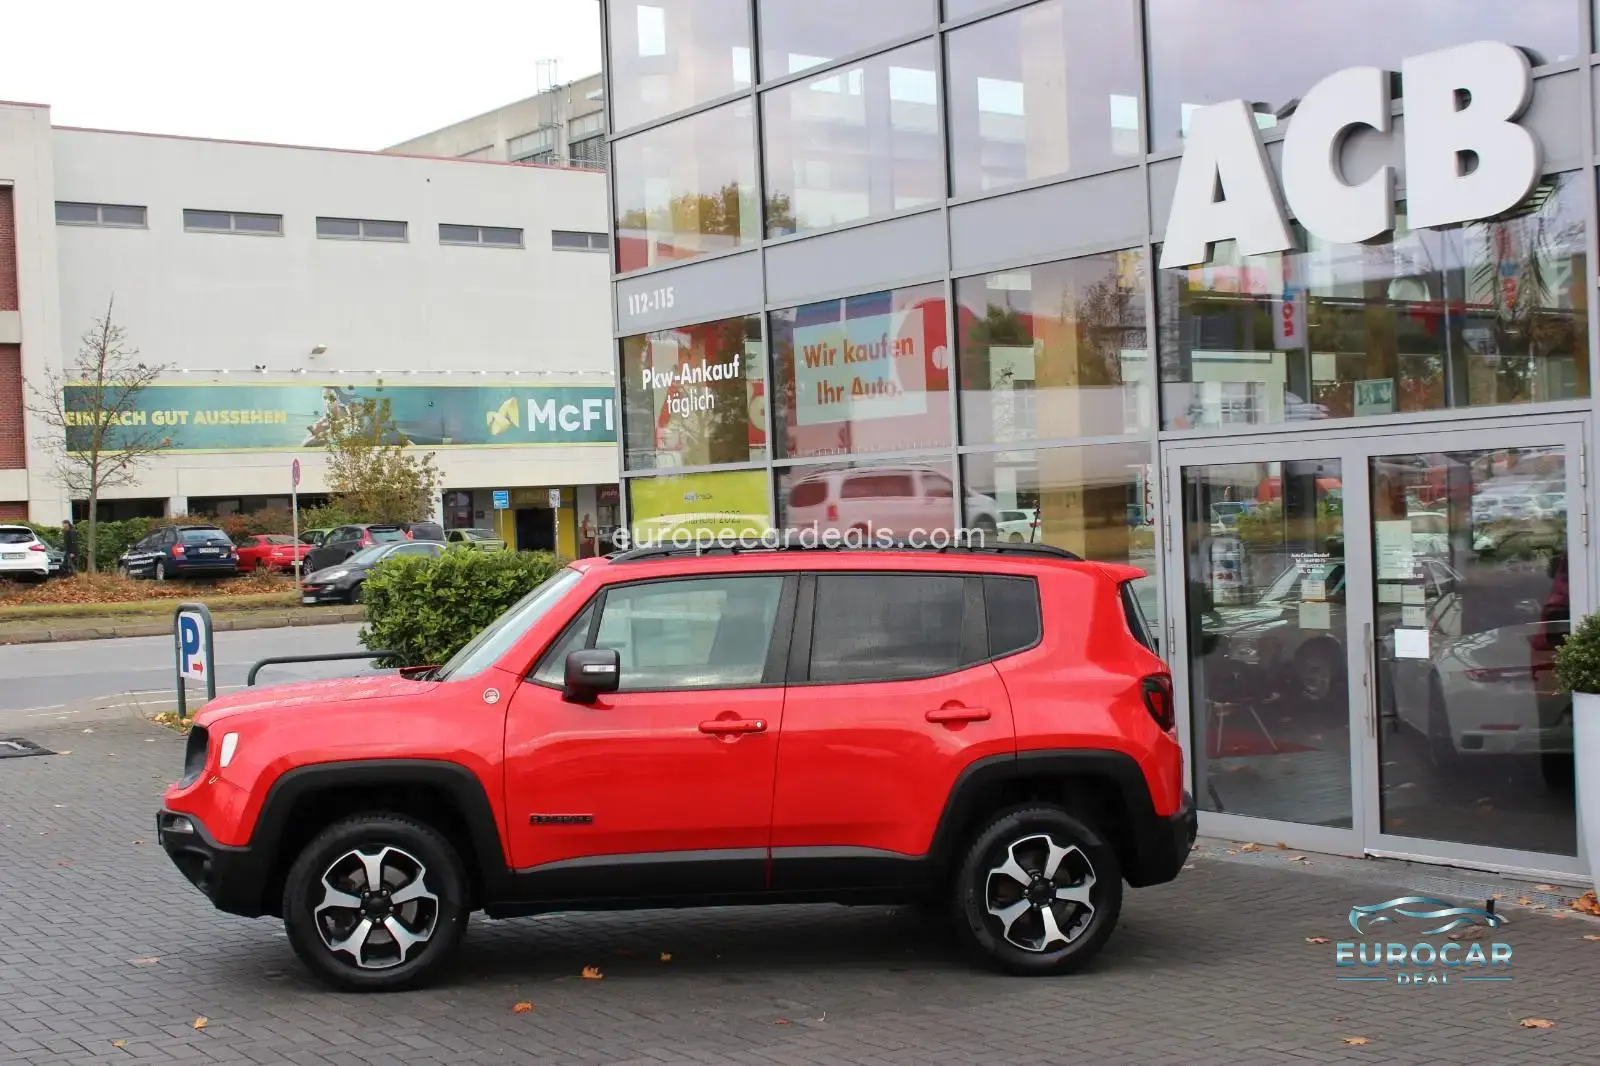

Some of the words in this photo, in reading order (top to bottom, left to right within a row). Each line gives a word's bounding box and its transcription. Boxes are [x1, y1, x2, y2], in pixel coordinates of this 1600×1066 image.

[1158, 40, 1543, 269] ACB
[628, 286, 674, 316] 112-115
[803, 342, 838, 368] Wir
[843, 332, 914, 364] kaufen
[641, 354, 740, 391] Pkw-Ankauf
[666, 390, 716, 418] täglich
[816, 379, 845, 405] Ihr
[65, 411, 147, 426] EINFACH
[151, 410, 189, 425] GUT
[192, 409, 288, 425] AUSSEHEN
[527, 398, 617, 432] McFI
[180, 616, 200, 673] P
